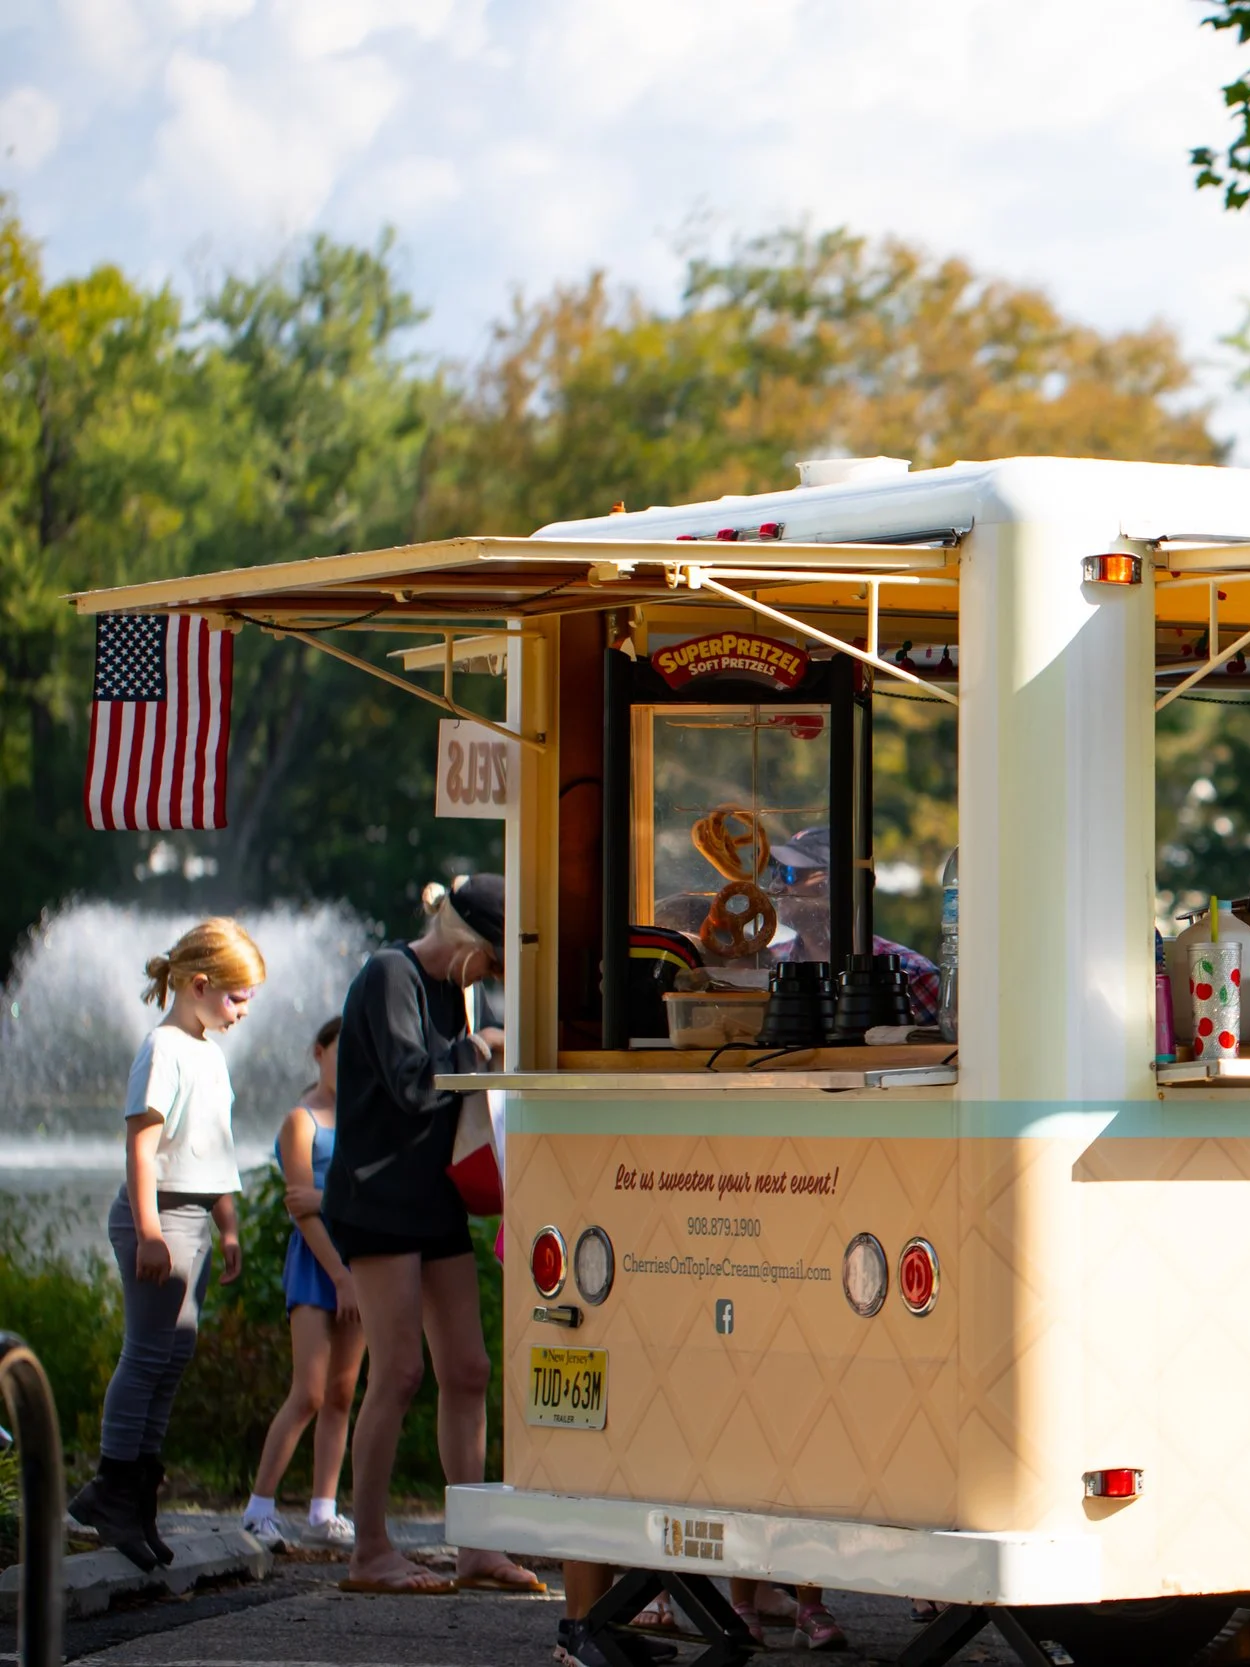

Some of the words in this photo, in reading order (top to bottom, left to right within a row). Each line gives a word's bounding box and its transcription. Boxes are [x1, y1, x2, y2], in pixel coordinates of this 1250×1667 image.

[688, 659, 719, 676] SOFT
[721, 656, 776, 676] PRETZELS
[614, 1163, 637, 1190] Let
[639, 1170, 655, 1191] us
[658, 1170, 715, 1193] sweeten
[718, 1171, 752, 1201] your
[754, 1171, 787, 1194] next
[790, 1166, 839, 1195] event!
[687, 1216, 761, 1237] 908.879.1900
[623, 1253, 831, 1283] CherriesOnTopIceCream@gmail.com
[548, 1348, 565, 1363] New
[565, 1349, 588, 1365] Jersey
[553, 1414, 575, 1424] TRAILER
